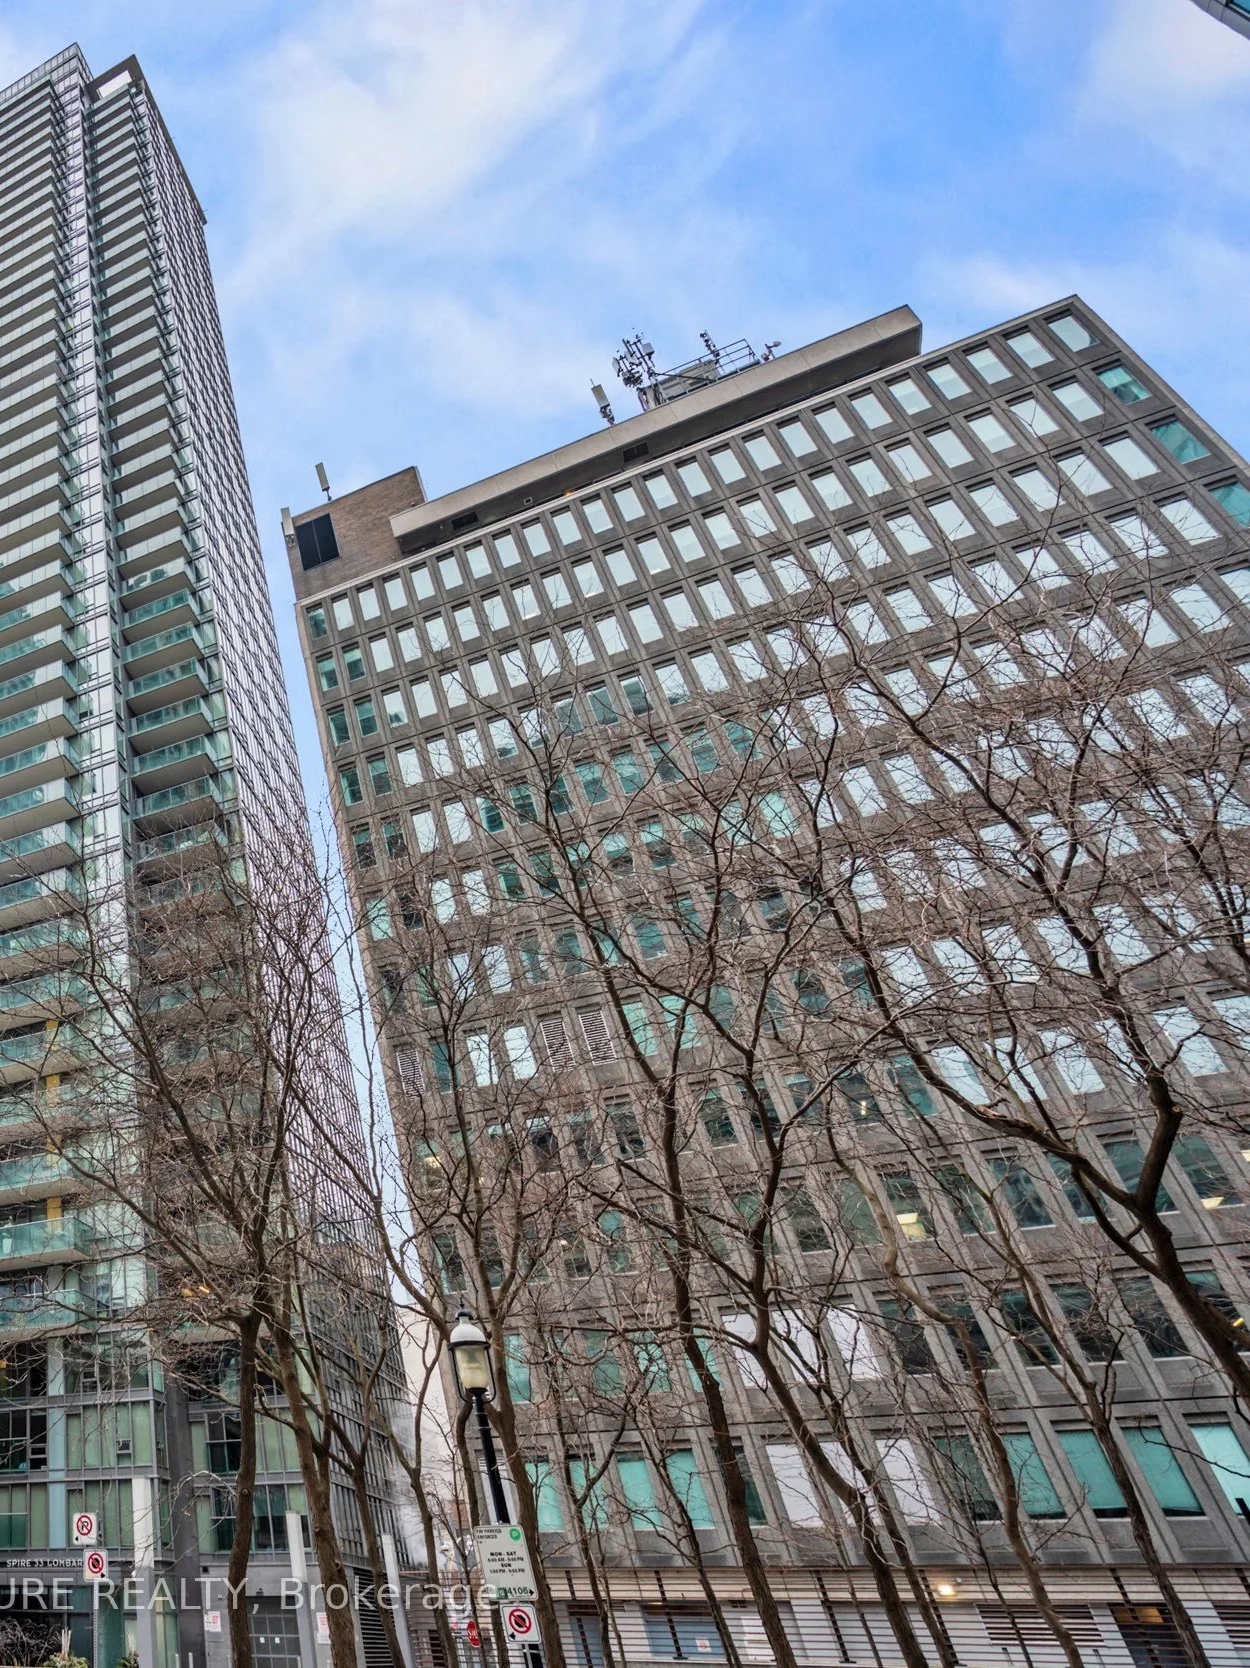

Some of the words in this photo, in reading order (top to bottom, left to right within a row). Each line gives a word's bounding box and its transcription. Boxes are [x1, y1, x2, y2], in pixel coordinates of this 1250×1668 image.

[6, 1559, 31, 1567] SPIRE
[34, 1559, 44, 1567] 33
[47, 1559, 83, 1567] LOMBAR
